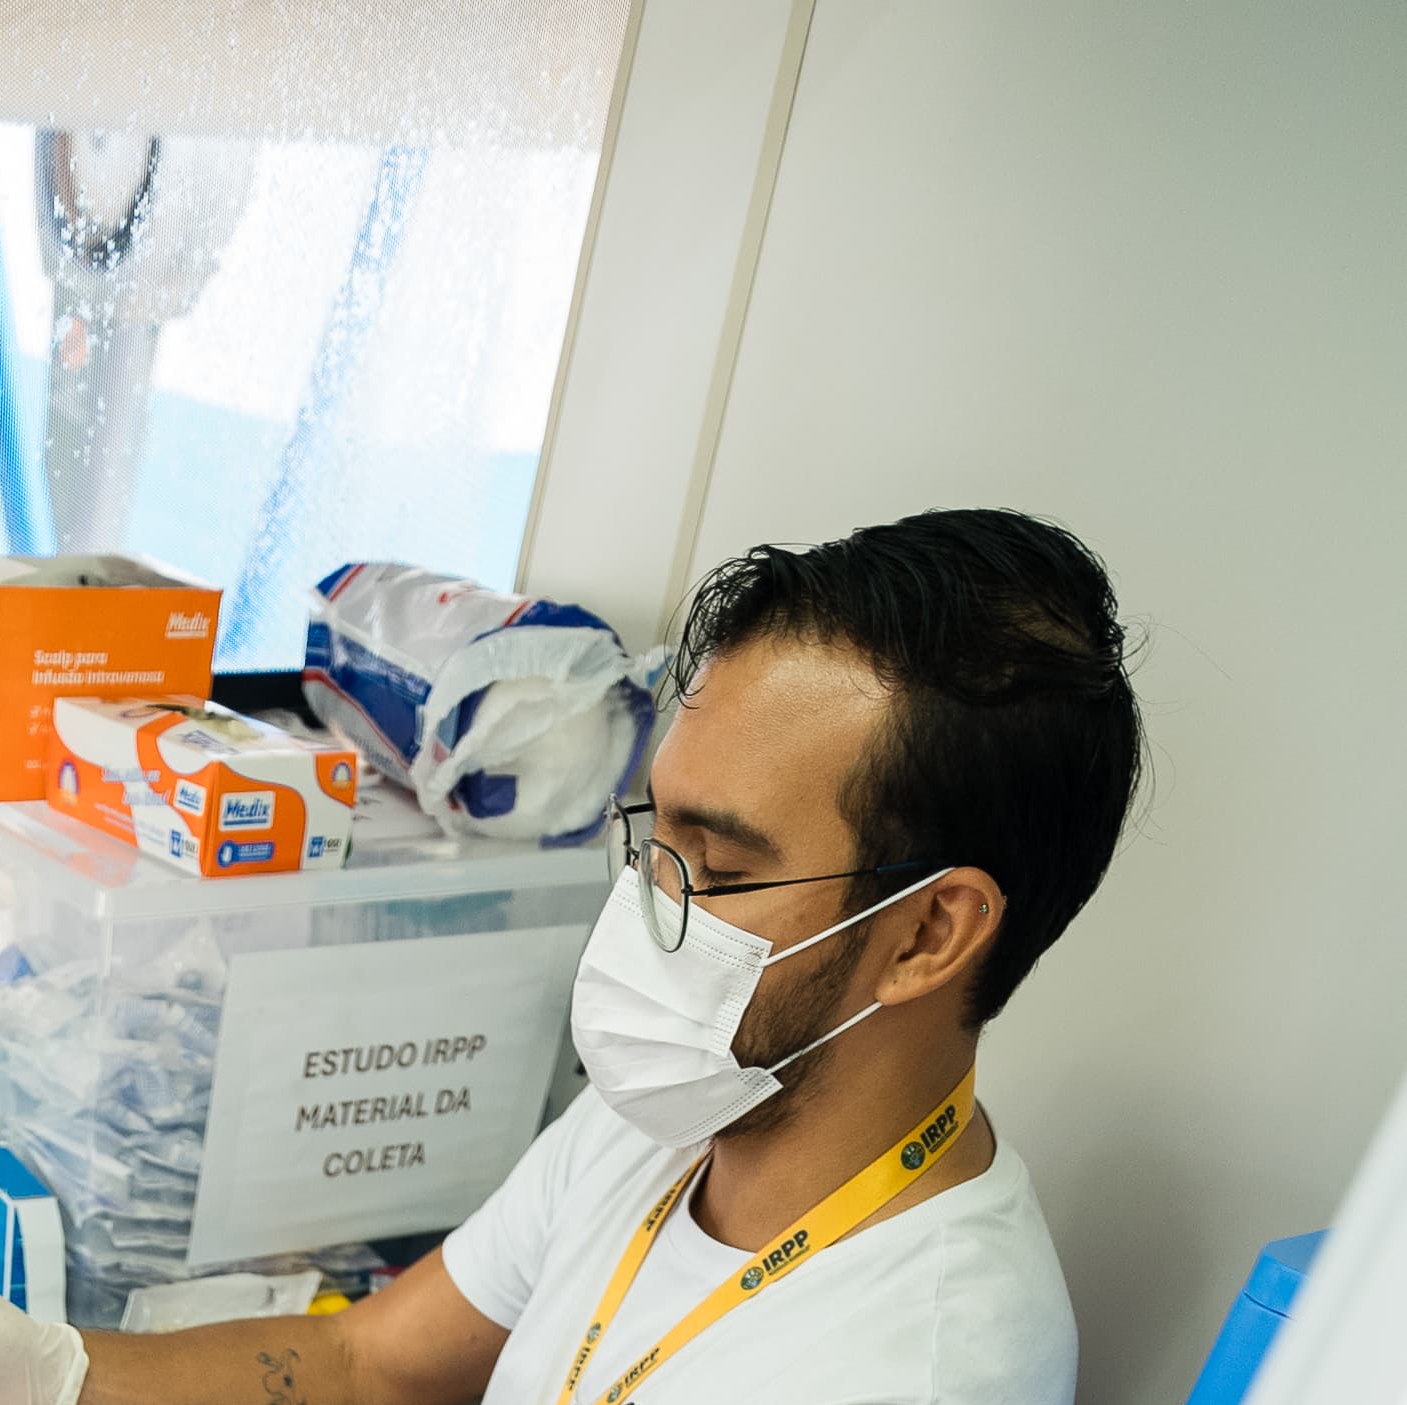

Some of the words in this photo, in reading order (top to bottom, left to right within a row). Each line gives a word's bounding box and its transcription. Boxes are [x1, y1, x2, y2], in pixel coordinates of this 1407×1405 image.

[224, 799, 269, 819] Medix
[303, 1042, 418, 1079] ESTUDO
[422, 1034, 487, 1066] IRPP
[295, 1092, 428, 1132] MATERIAL
[434, 1086, 472, 1115] DA
[920, 1104, 956, 1149] IRPP
[322, 1142, 426, 1178] COLETA
[762, 1229, 808, 1272] IRPP
[624, 1347, 660, 1385] IRPP
